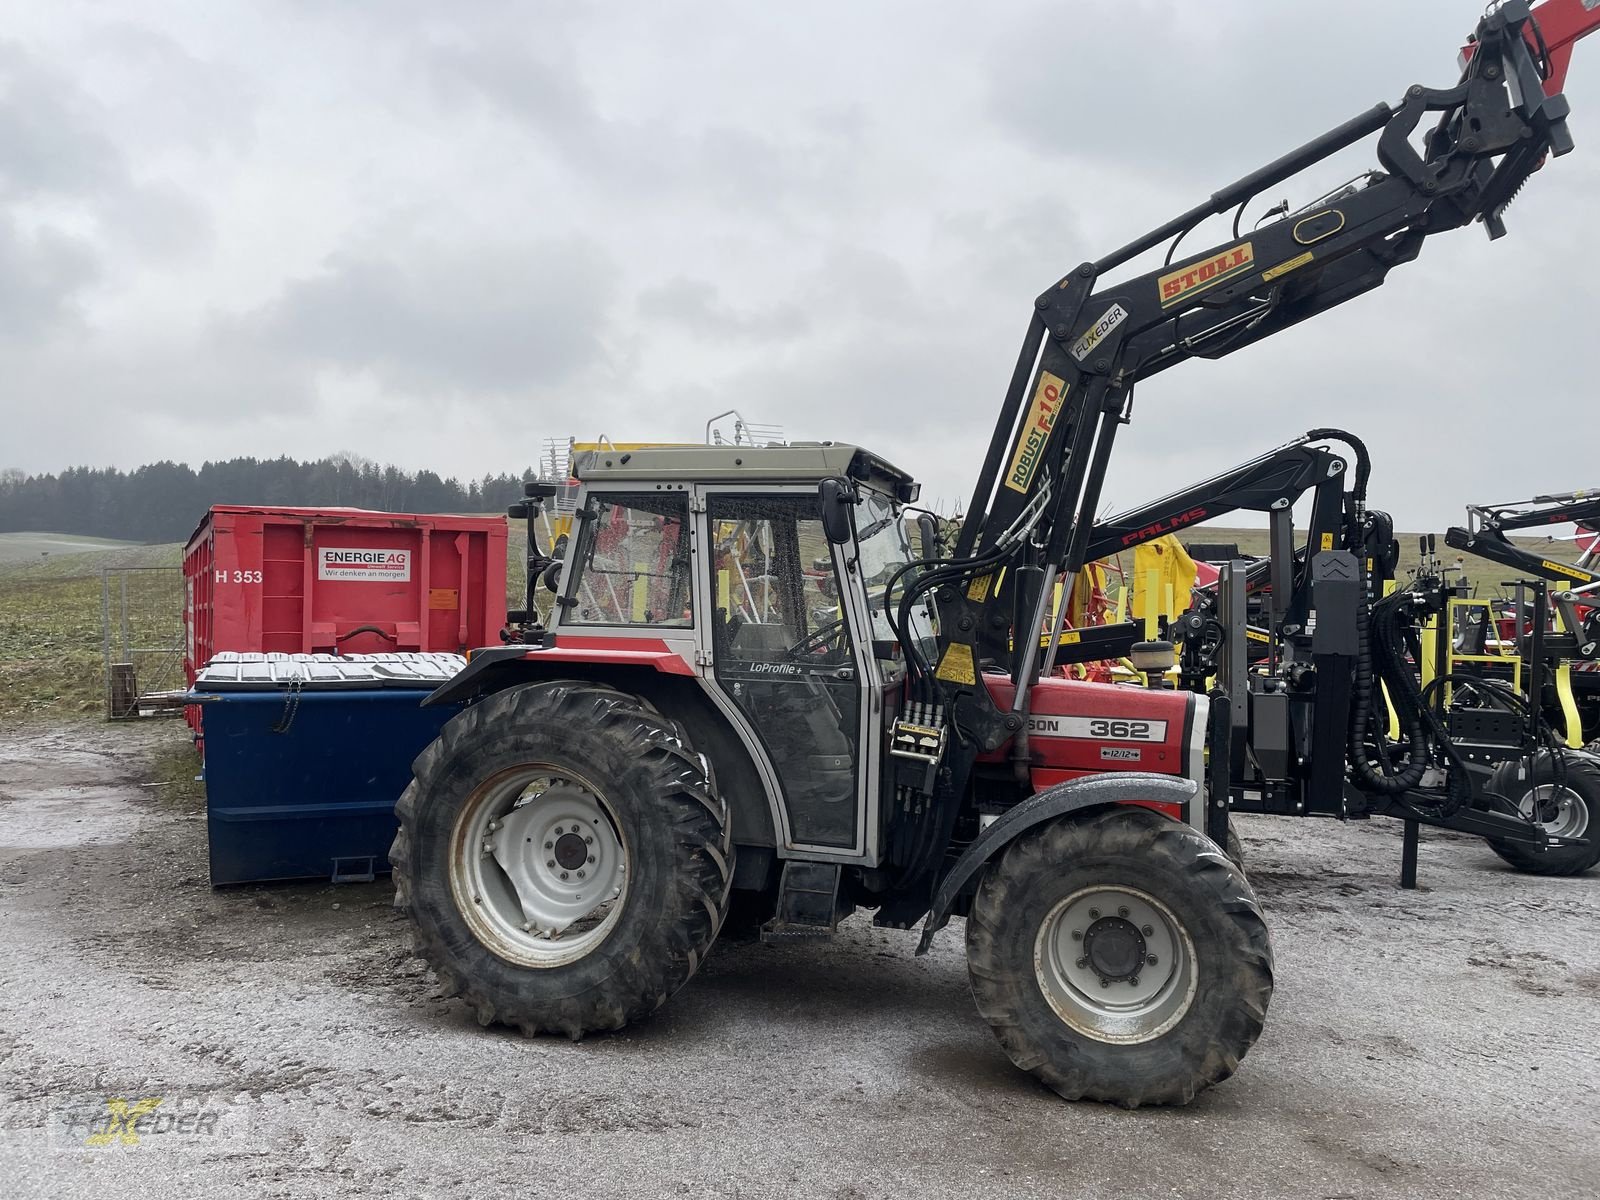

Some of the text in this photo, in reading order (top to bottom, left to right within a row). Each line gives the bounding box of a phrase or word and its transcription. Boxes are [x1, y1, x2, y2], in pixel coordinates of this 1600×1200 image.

[1163, 248, 1249, 299] STOLL
[1075, 308, 1122, 357] FLIXEDER
[1012, 384, 1059, 488] ROBUST F10
[1121, 507, 1207, 545] PALMS
[215, 570, 263, 583] H 353
[1090, 720, 1150, 739] 362
[1110, 750, 1132, 759] 12/12
